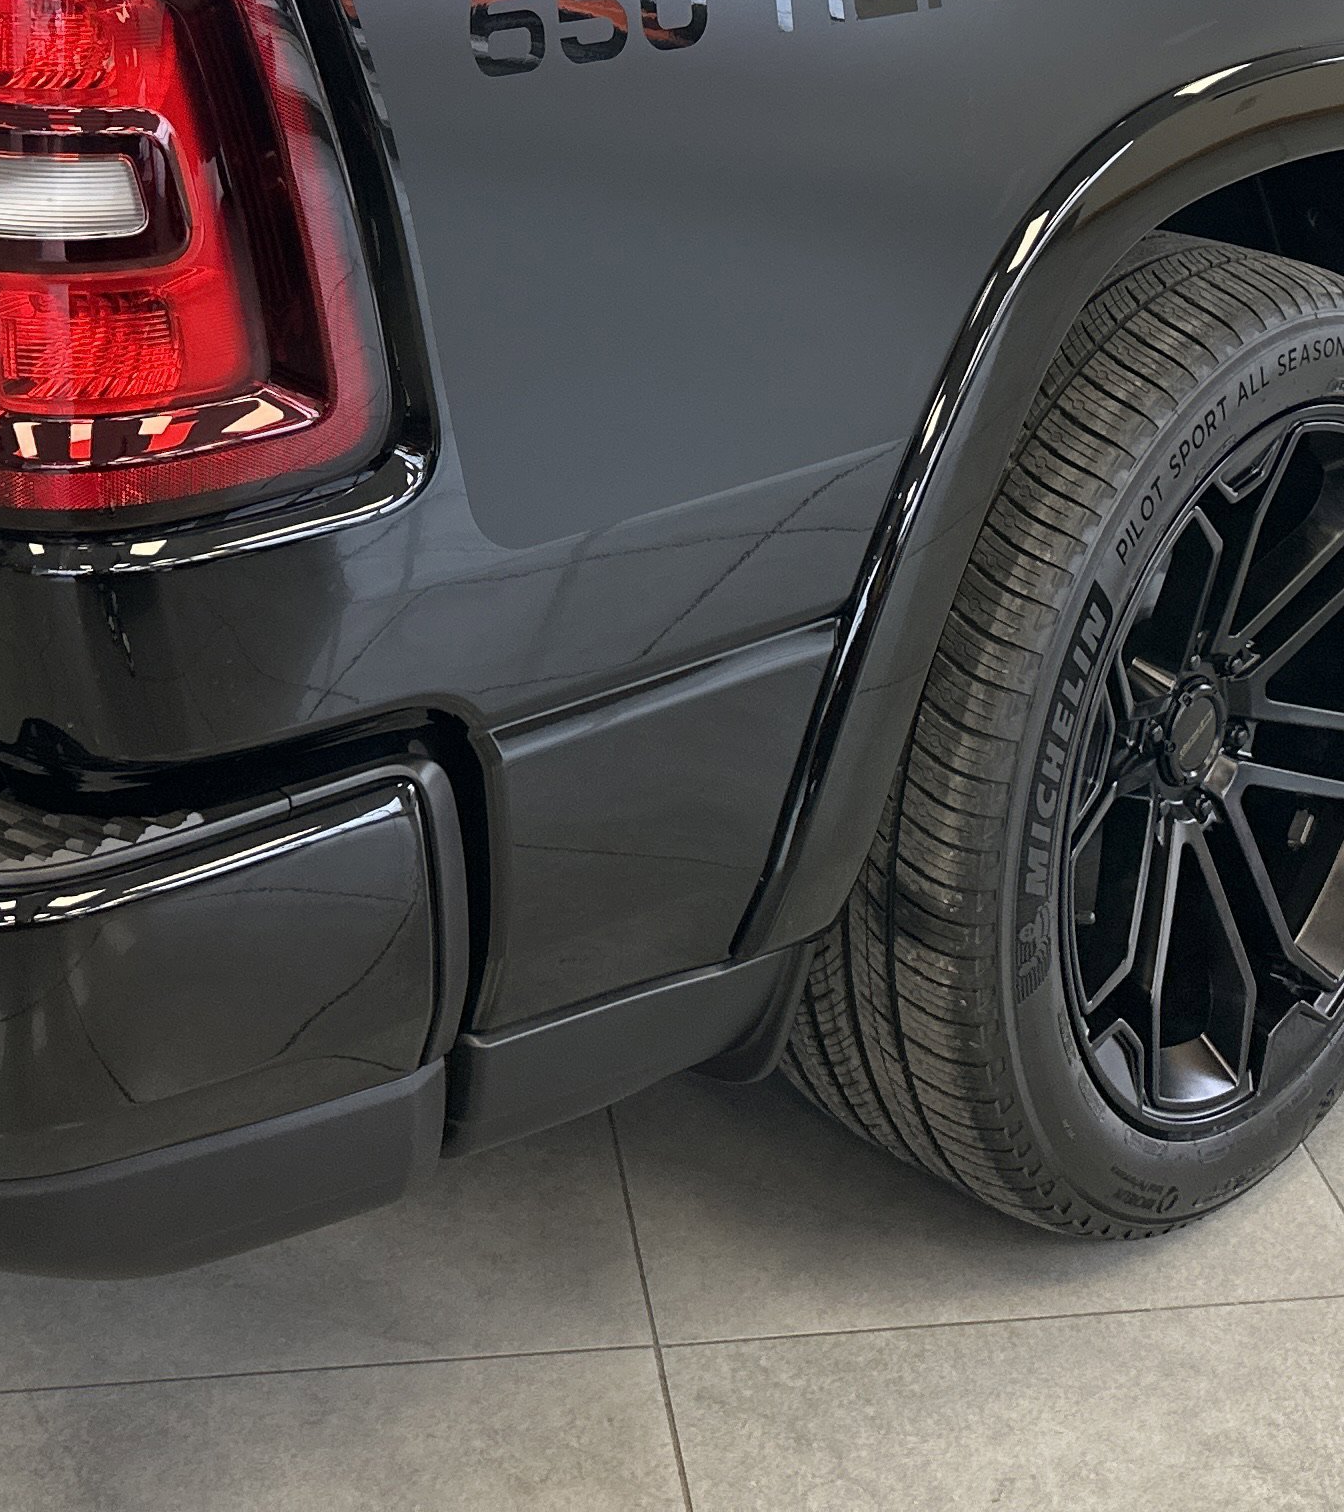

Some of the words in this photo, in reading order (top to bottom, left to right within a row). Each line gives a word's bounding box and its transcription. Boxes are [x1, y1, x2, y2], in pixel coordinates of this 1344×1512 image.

[1115, 476, 1164, 566] PILOT
[1169, 395, 1228, 479] SPORT
[1236, 366, 1270, 408] ALL
[1025, 601, 1107, 897] MICHELIN
